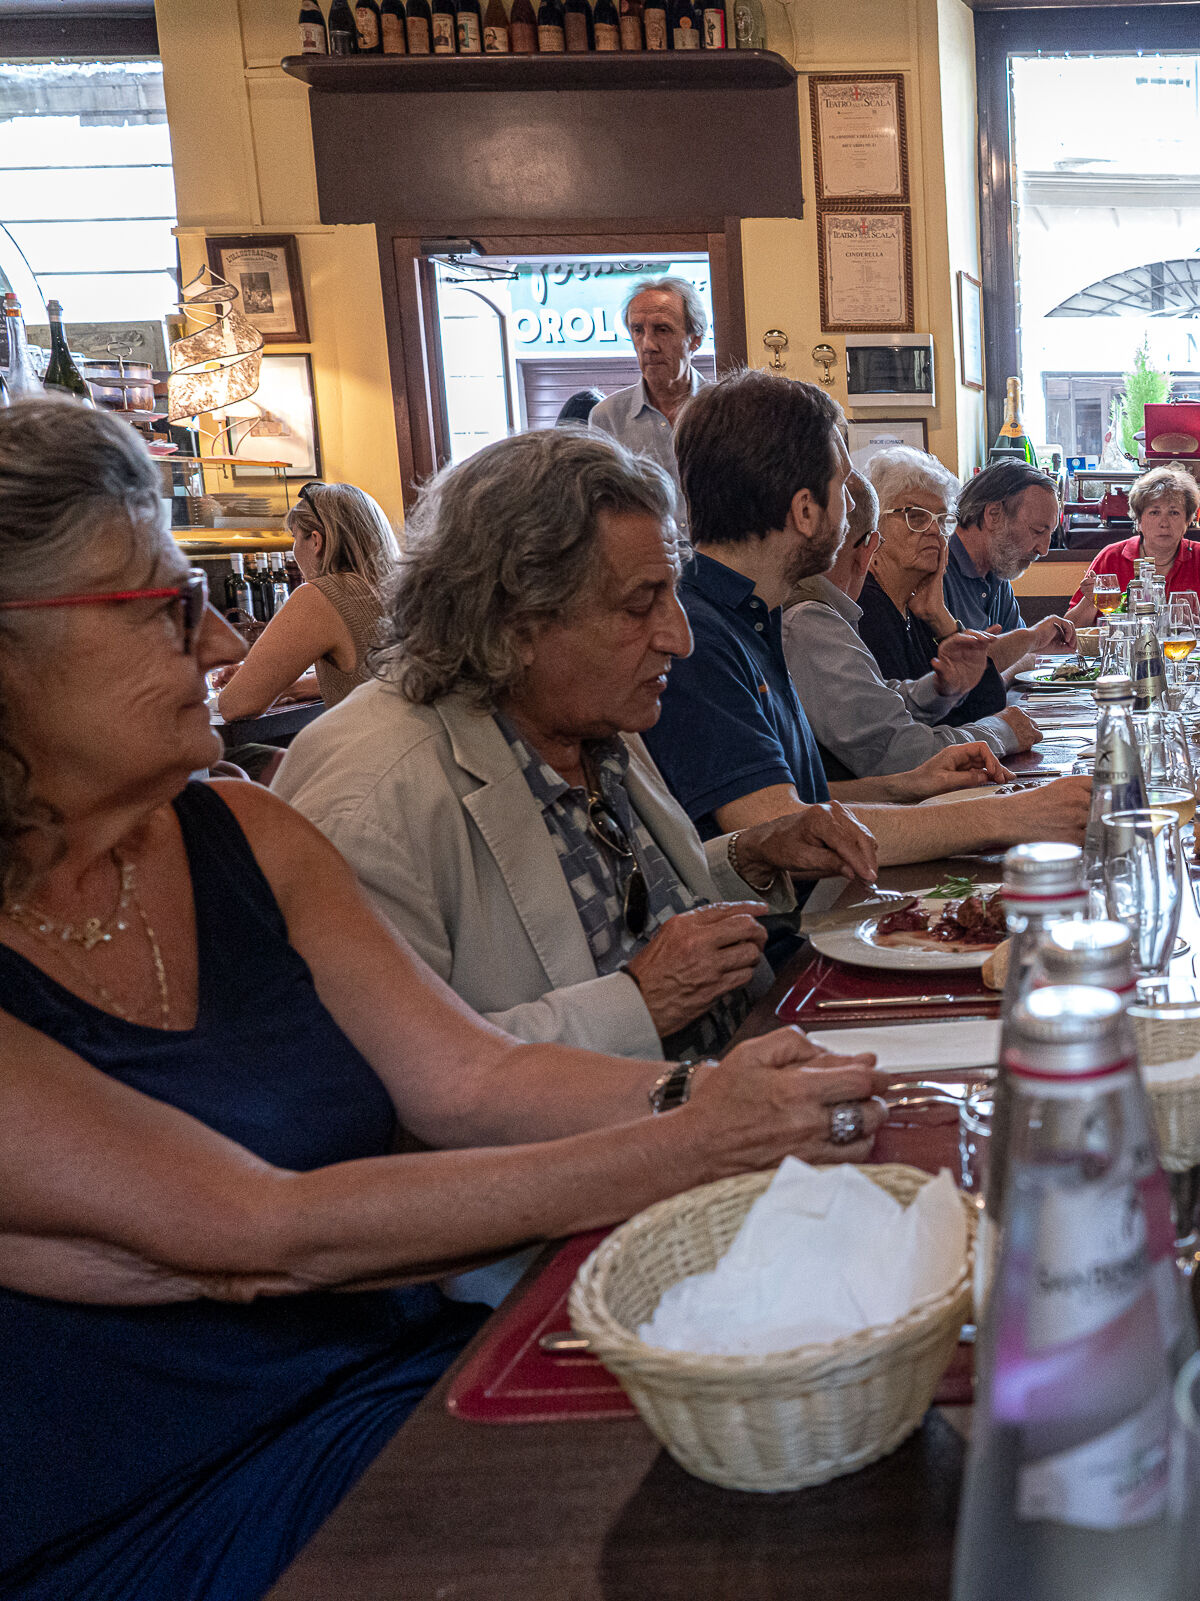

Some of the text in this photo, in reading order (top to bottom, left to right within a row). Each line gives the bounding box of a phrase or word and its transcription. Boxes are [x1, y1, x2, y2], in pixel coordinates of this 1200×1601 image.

[825, 98, 852, 108] TEATRO
[864, 97, 891, 107] SCALA
[833, 230, 896, 239] TEATRO SCALA
